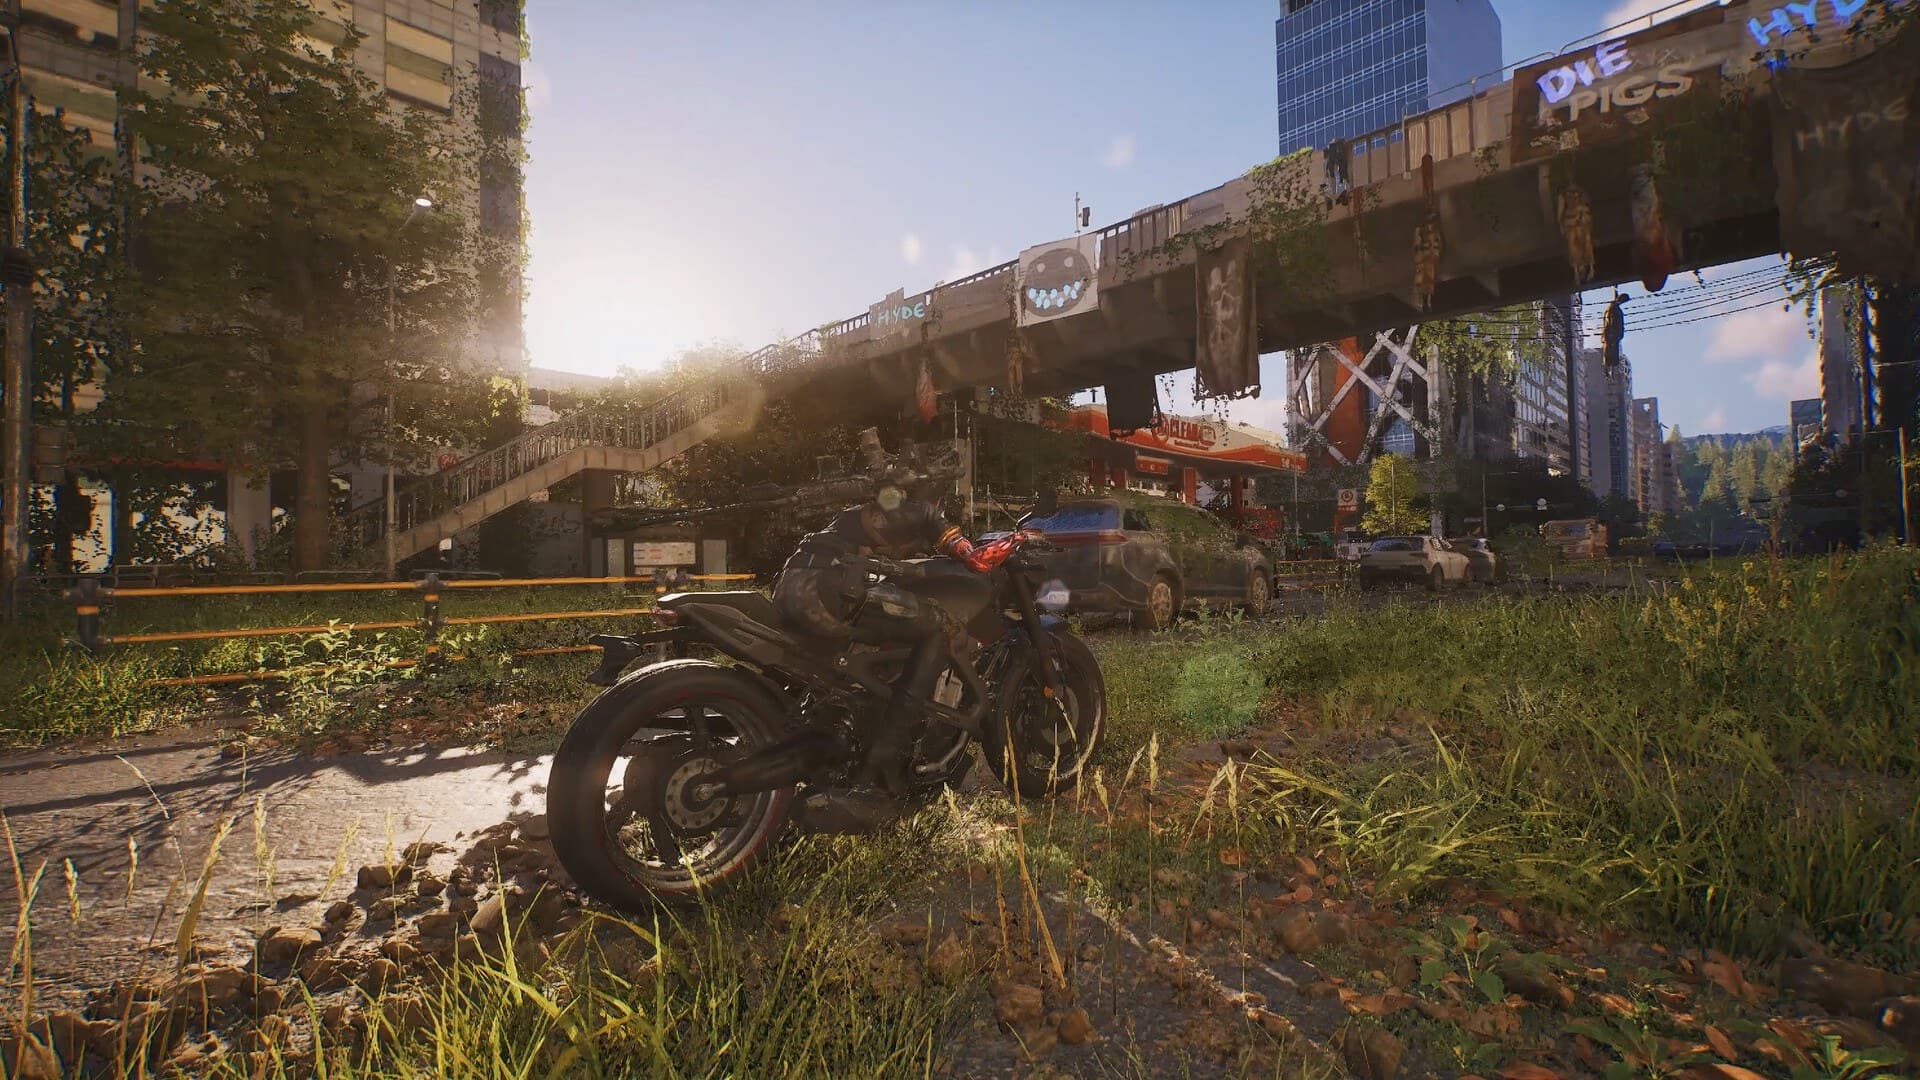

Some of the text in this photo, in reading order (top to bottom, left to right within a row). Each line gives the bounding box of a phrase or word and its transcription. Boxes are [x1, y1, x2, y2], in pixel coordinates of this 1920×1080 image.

[1535, 39, 1633, 104] DIE
[1569, 63, 1694, 122] PIGS
[1795, 96, 1910, 152] HYDE
[876, 302, 925, 328] HYDE
